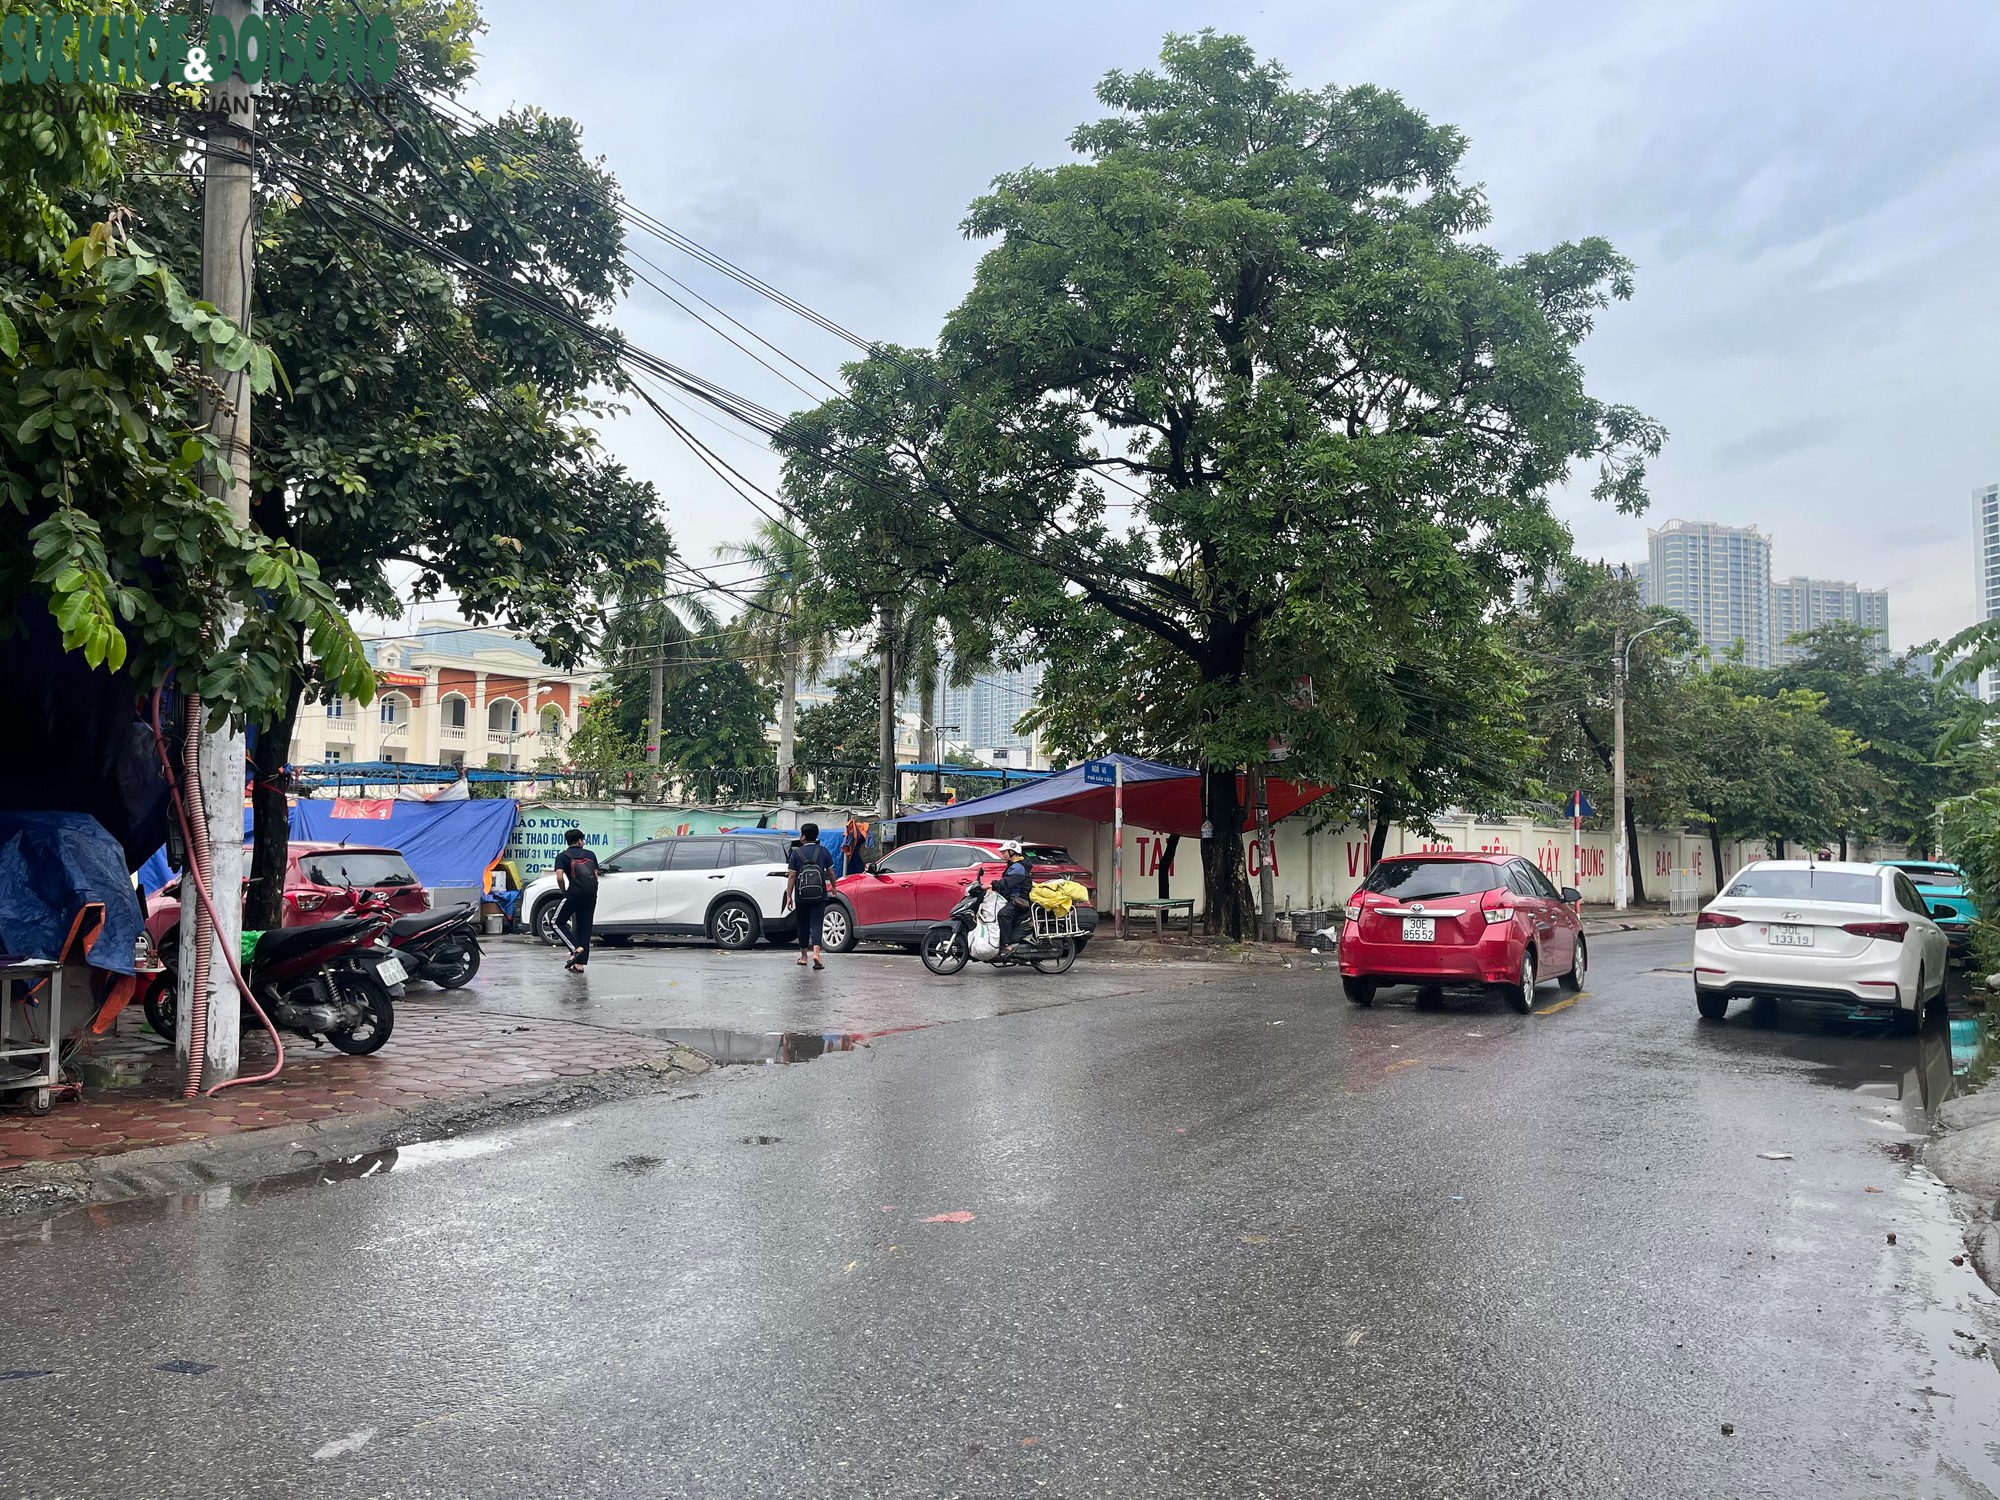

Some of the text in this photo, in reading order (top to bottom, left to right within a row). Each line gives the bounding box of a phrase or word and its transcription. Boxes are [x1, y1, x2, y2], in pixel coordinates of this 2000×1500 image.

[515, 816, 580, 828] ÀO MỪNG
[526, 833, 549, 845] THAO
[551, 830, 567, 845] ĐÔ
[583, 834, 601, 846] AM
[531, 849, 541, 859] 31
[1410, 919, 1427, 929] 30E
[1781, 925, 1802, 935] 30L
[1774, 934, 1809, 945] 133.19
